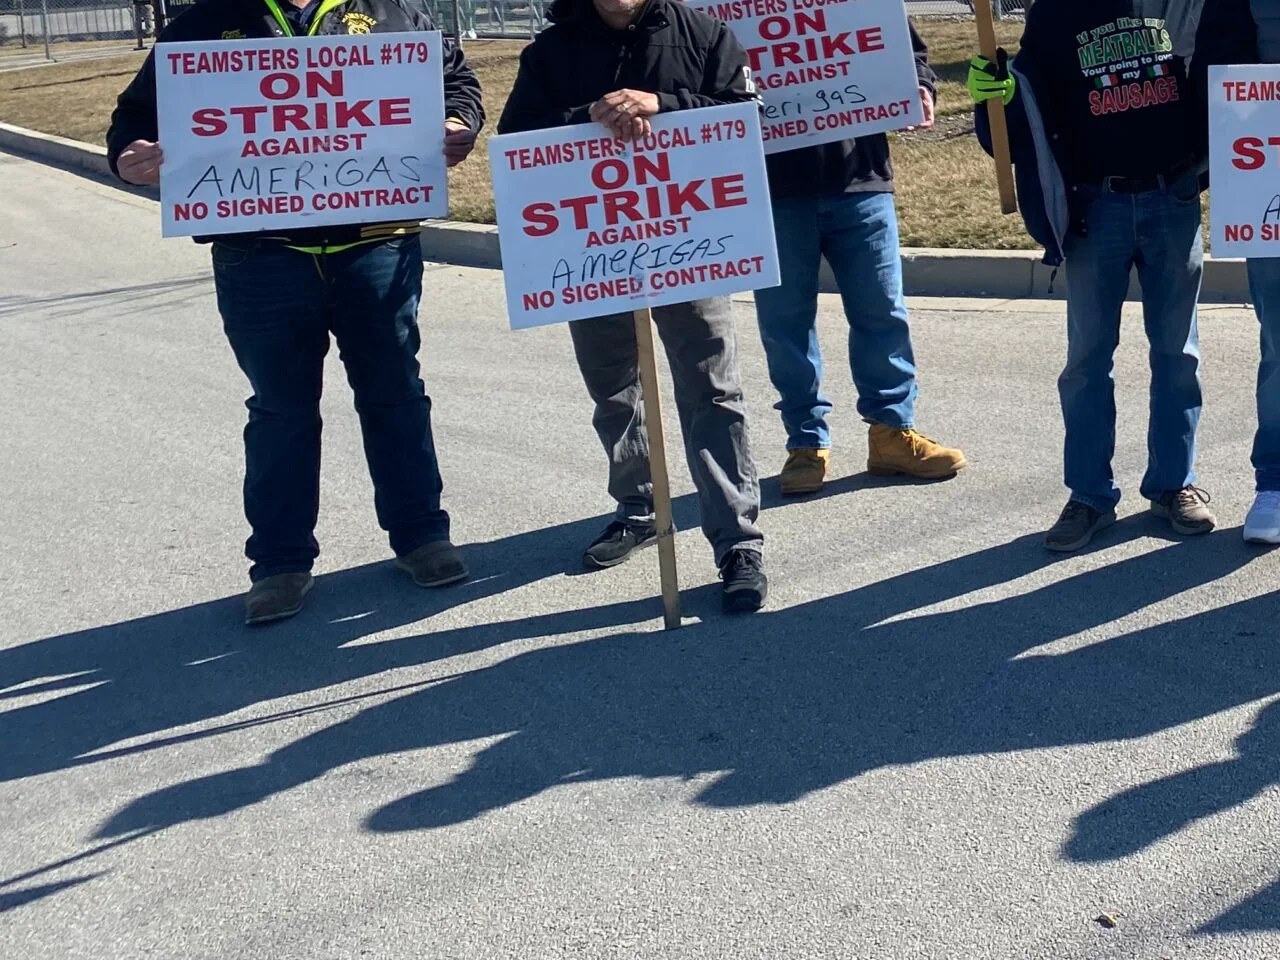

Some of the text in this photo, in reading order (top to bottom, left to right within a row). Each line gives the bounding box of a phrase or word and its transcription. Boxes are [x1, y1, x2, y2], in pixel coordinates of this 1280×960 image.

[758, 8, 827, 41] ON
[1090, 22, 1116, 41] you
[1117, 17, 1142, 30] like
[167, 41, 428, 75] TEAMSTERS LOCAL #179
[746, 26, 885, 73] TRIKE
[1078, 29, 1173, 69] MEATBALLS
[1082, 64, 1106, 77] Your
[1109, 59, 1139, 74] going
[1141, 55, 1152, 65] to
[259, 69, 344, 101] ON
[754, 61, 849, 91] AGAINST
[1122, 70, 1141, 79] my
[1088, 76, 1179, 116] SAUSAGE
[191, 97, 412, 137] STRIKE
[761, 99, 911, 142] GNED CONTRACT
[241, 133, 368, 158] AGAINST
[505, 119, 746, 171] TEAMSTERS LOCAL #179
[590, 151, 671, 191] ON
[174, 185, 433, 222] NO SIGNED CONTRACT
[521, 173, 748, 237] STRIKE
[586, 216, 690, 248] AGAINST
[1224, 224, 1254, 242] NO
[523, 255, 764, 311] NO SIGNED CONTRACT
